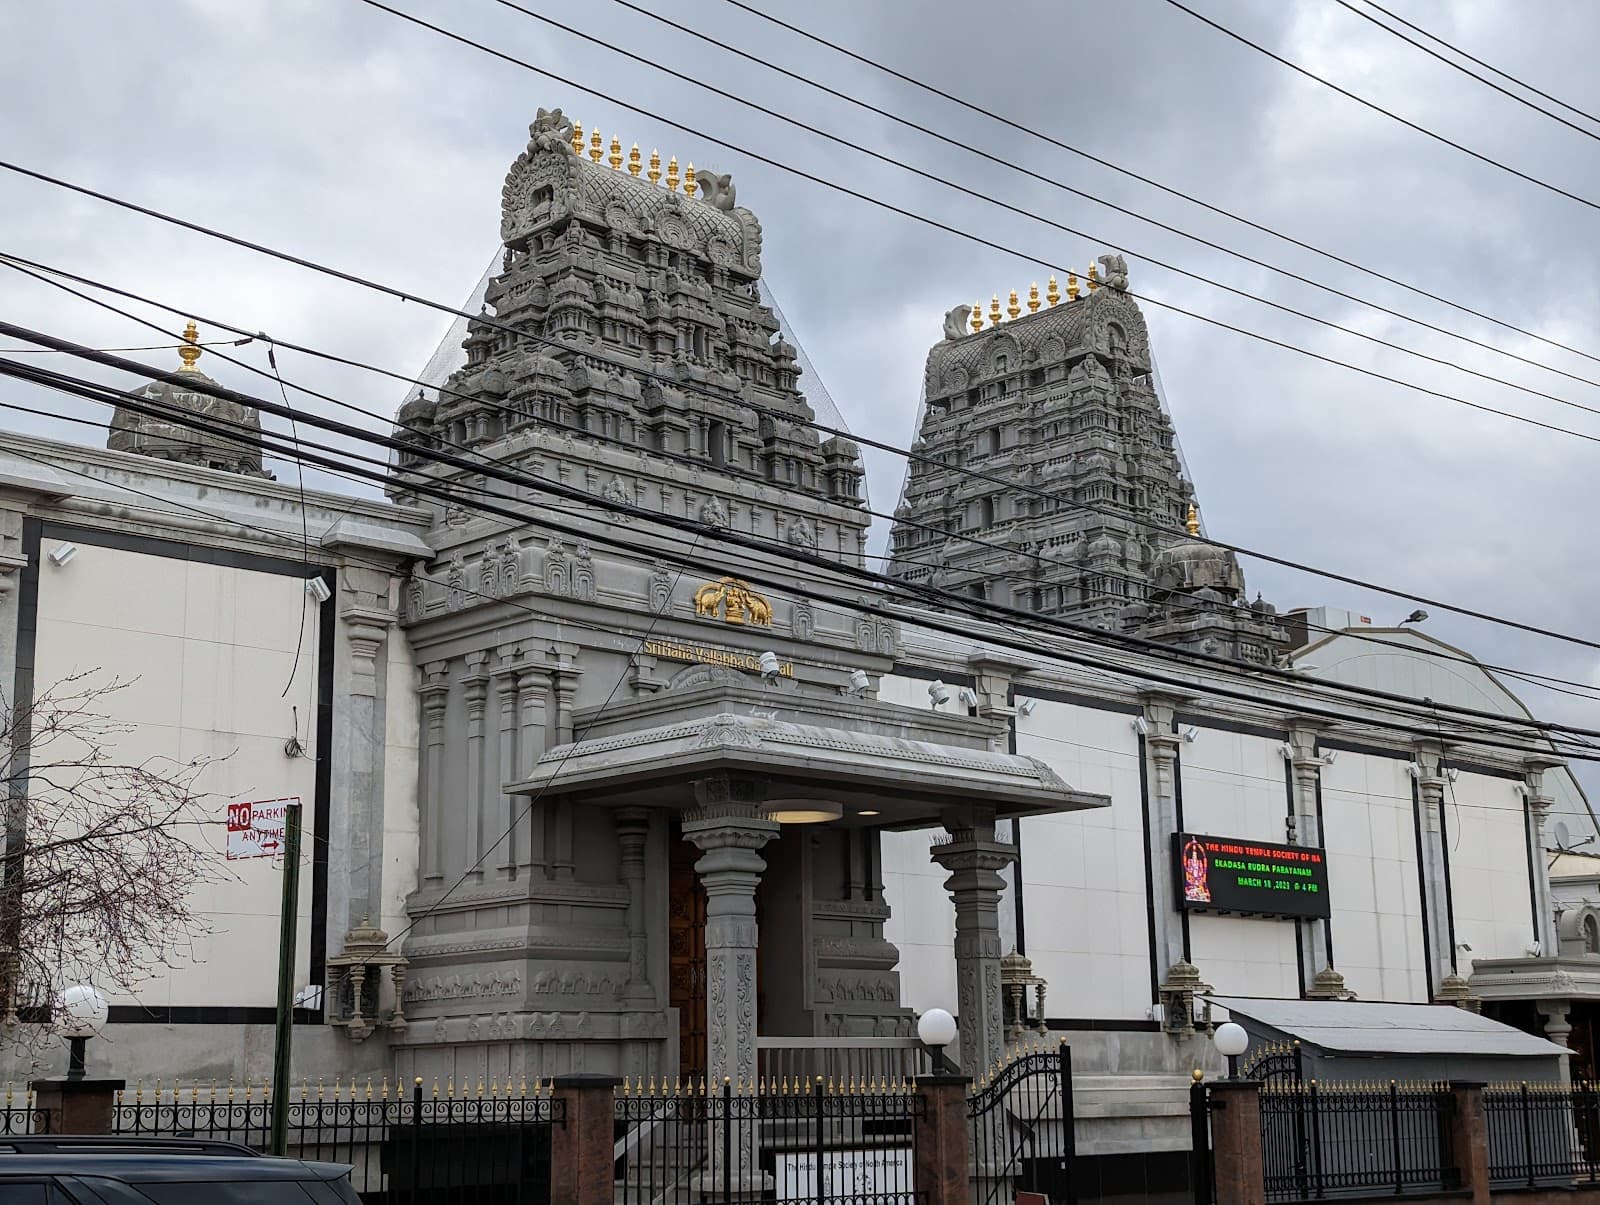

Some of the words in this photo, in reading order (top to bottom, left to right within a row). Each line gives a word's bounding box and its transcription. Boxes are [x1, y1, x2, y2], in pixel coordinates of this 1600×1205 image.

[745, 655, 793, 677] Gaati
[229, 807, 250, 828] NO
[242, 827, 285, 842] ANYTIME
[1205, 842, 1219, 851] THE
[1221, 844, 1244, 855] HINDU
[1245, 846, 1271, 857] TEMPLE
[1273, 849, 1299, 860] SOCIETY
[1301, 853, 1310, 862] OF
[1215, 859, 1246, 870] EKADASA
[1248, 863, 1271, 873] RUDRA
[1272, 865, 1312, 876] PARAYANAM
[1238, 877, 1262, 888] MARCH
[1302, 883, 1307, 892] 4
[865, 1159, 880, 1168] Noth
